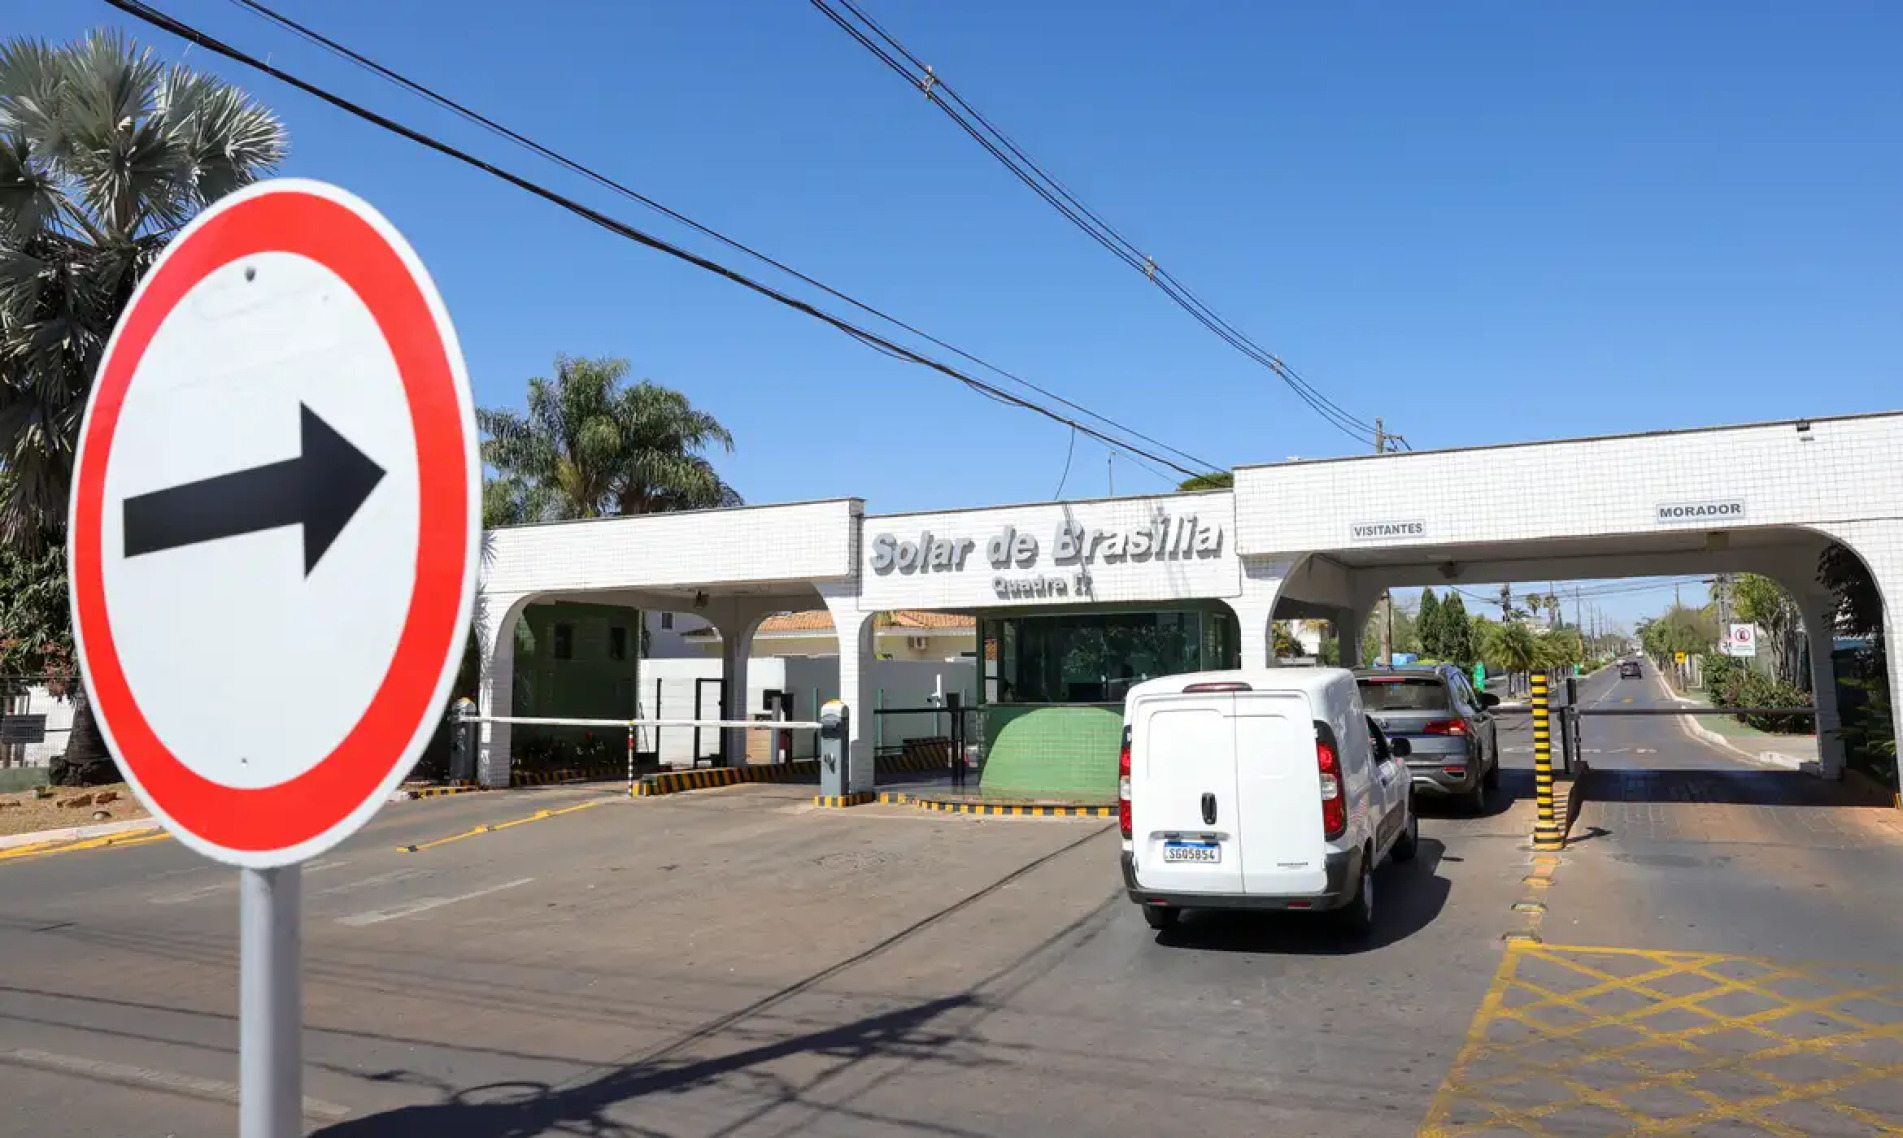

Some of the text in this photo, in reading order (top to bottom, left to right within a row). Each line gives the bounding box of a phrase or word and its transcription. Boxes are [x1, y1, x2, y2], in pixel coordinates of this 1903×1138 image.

[1659, 502, 1742, 518] MORADOR
[1353, 522, 1423, 538] VISITANTES
[869, 529, 975, 576] Solar
[986, 524, 1039, 570] de
[992, 574, 1068, 600] Quadra
